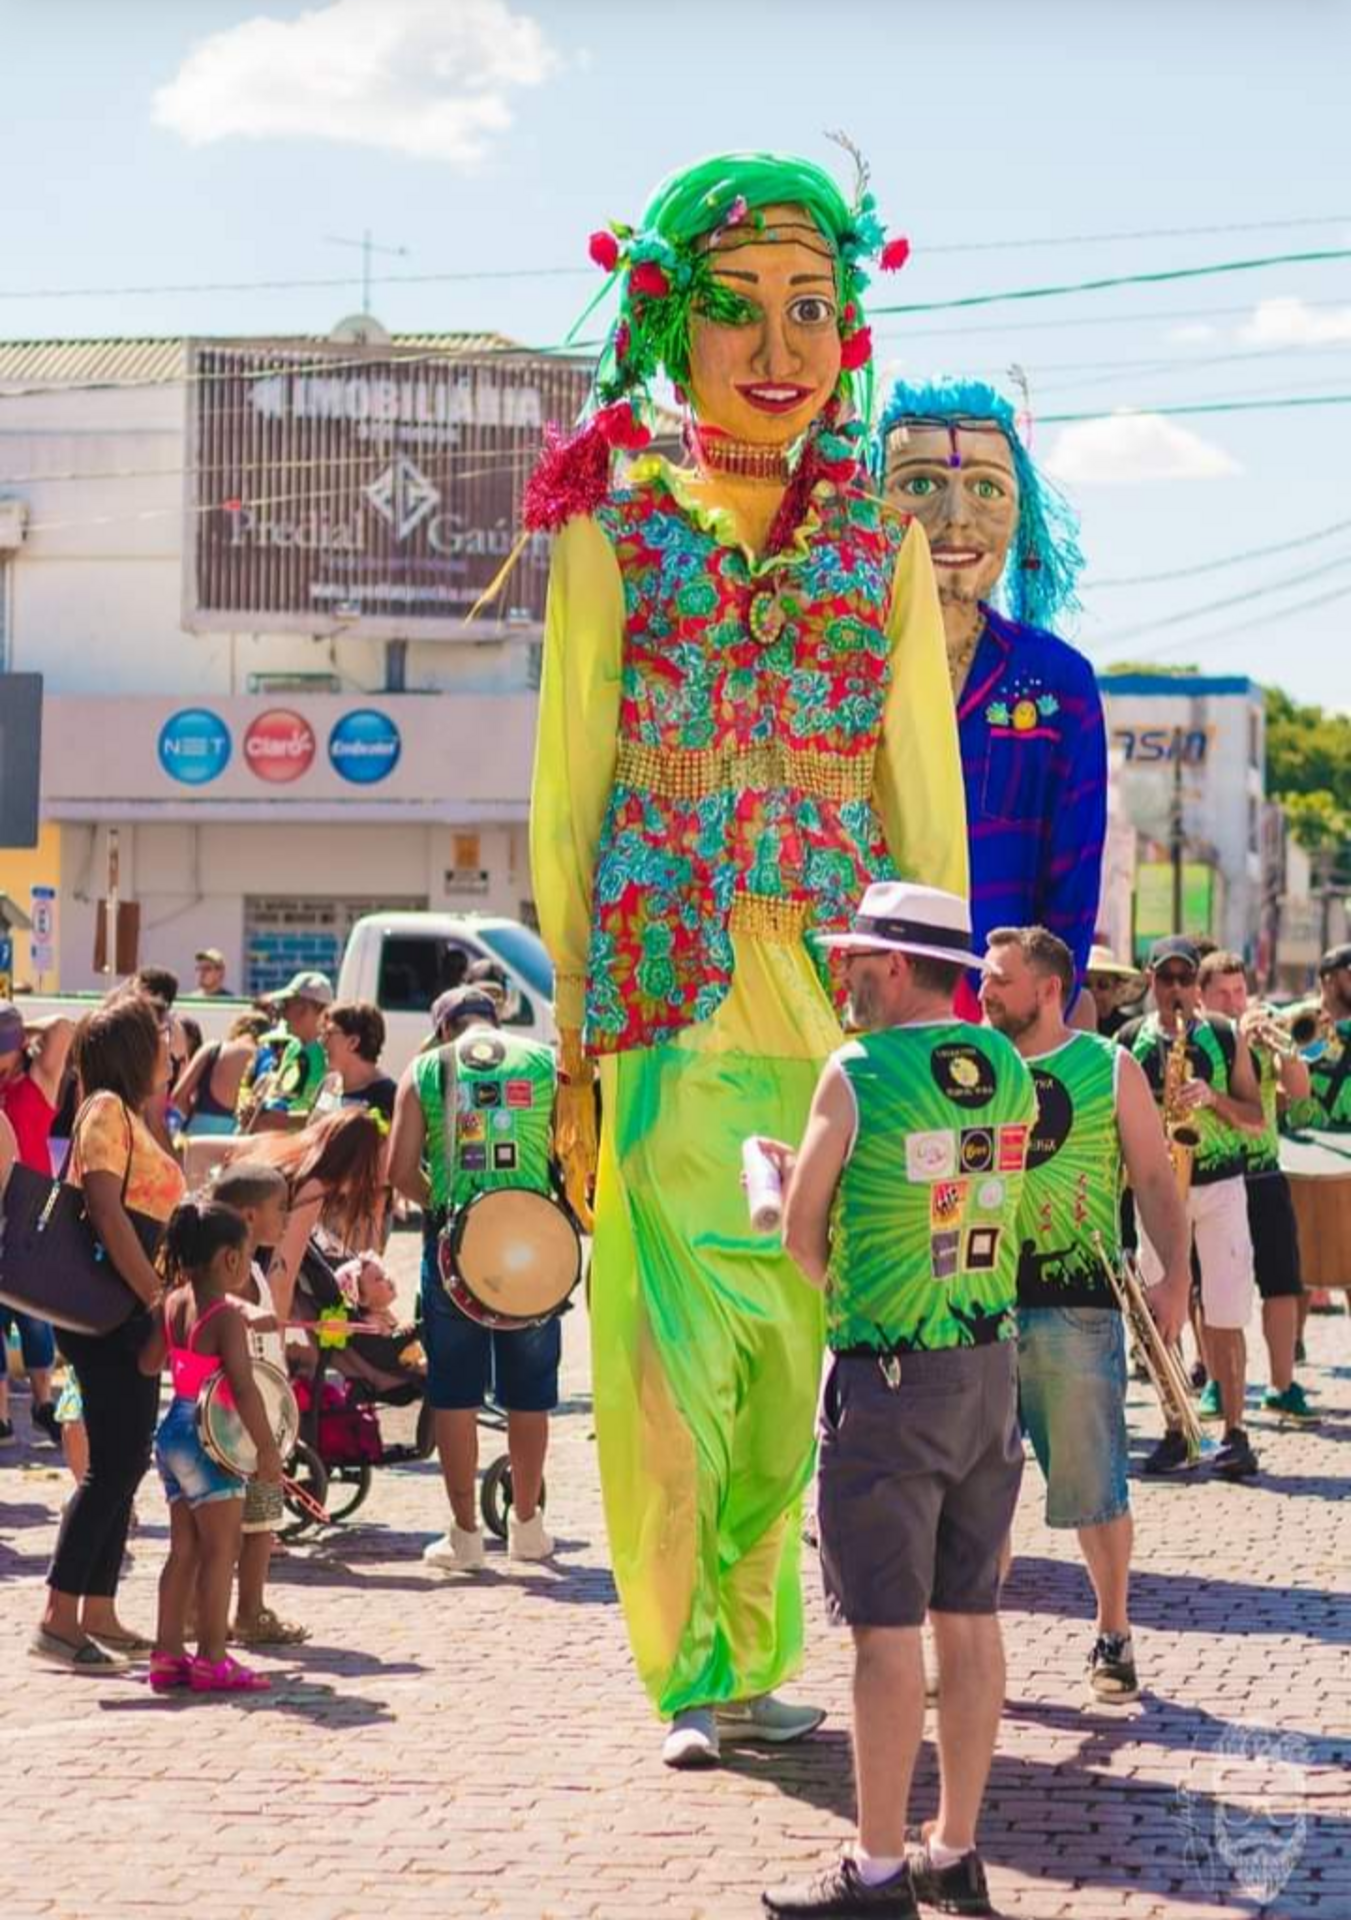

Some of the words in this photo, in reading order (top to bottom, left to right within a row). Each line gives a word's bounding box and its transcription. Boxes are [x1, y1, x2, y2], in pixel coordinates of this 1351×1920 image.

[230, 510, 366, 550] Predial
[163, 735, 226, 757] NET
[247, 730, 309, 758] Claro
